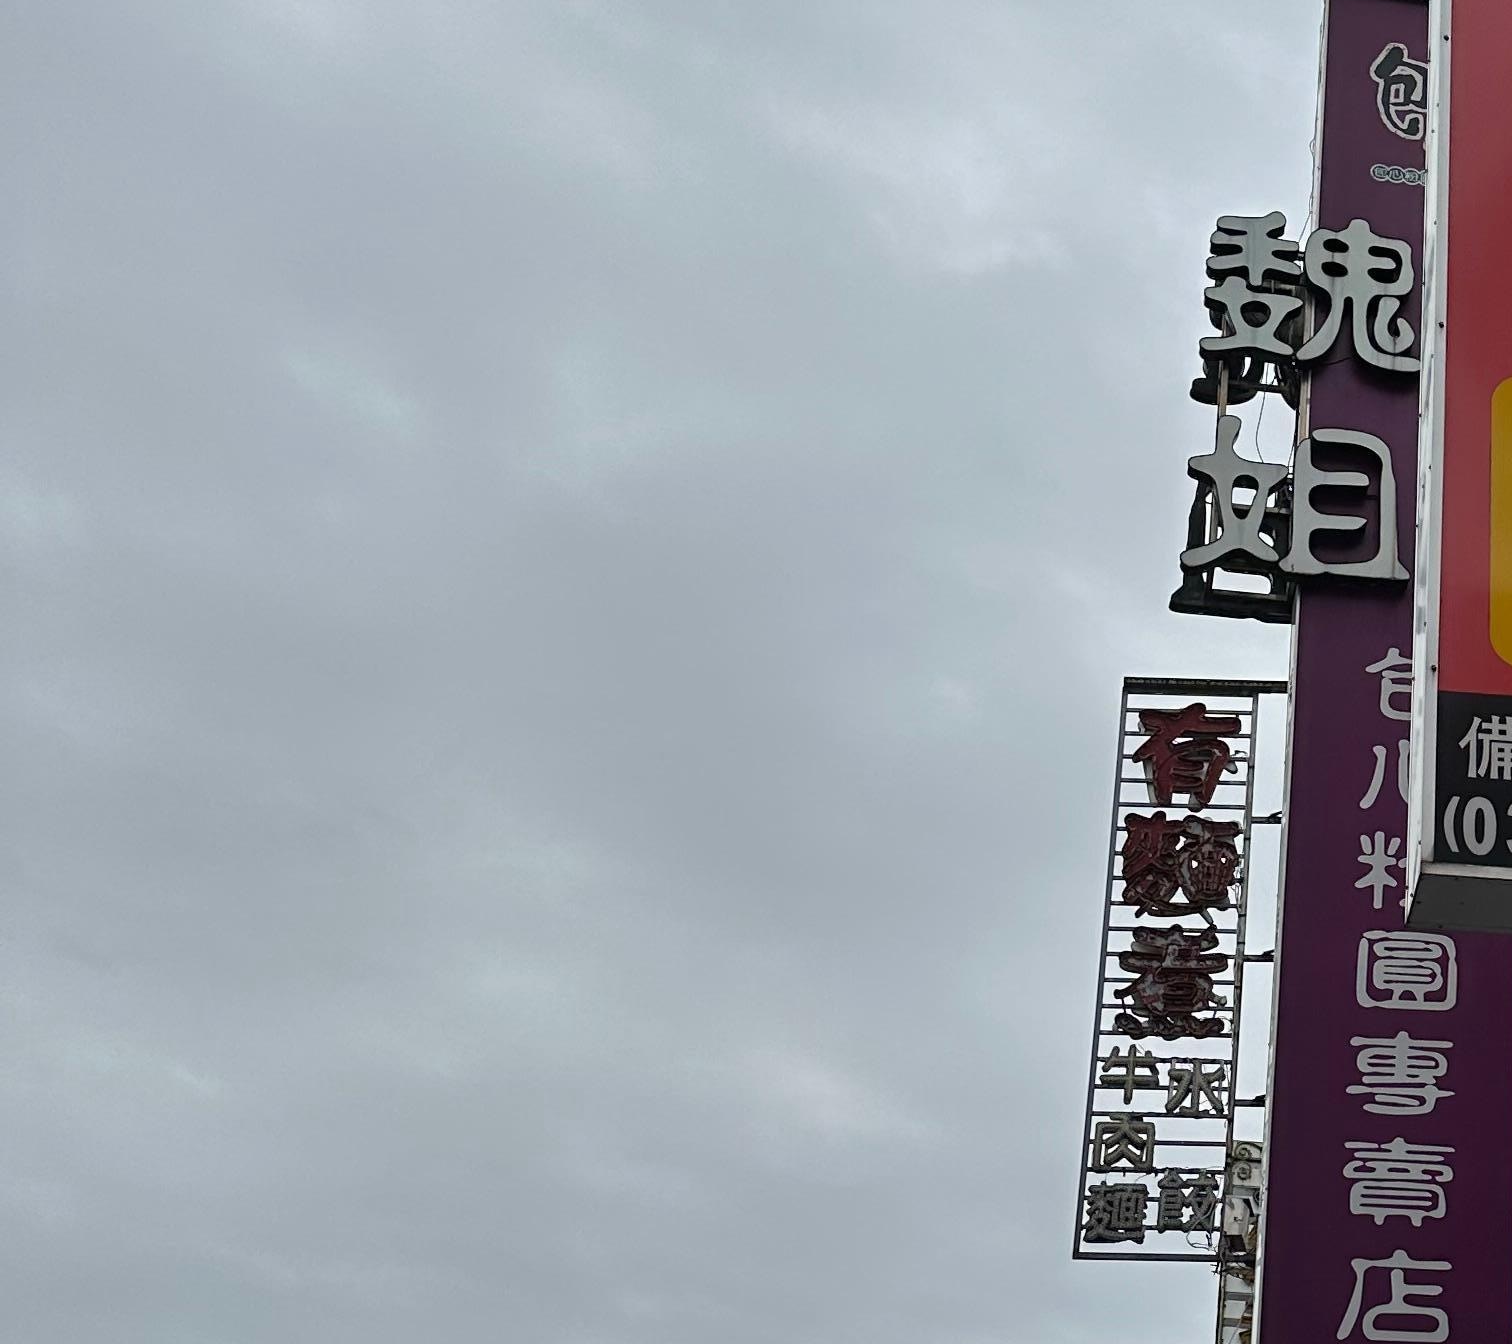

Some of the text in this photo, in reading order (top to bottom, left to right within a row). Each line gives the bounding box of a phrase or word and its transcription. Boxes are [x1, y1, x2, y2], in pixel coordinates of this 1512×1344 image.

[1180, 211, 1420, 581] 魏姐
[1083, 1044, 1160, 1244] 牛肉麵
[1156, 1059, 1226, 1233] 水餃
